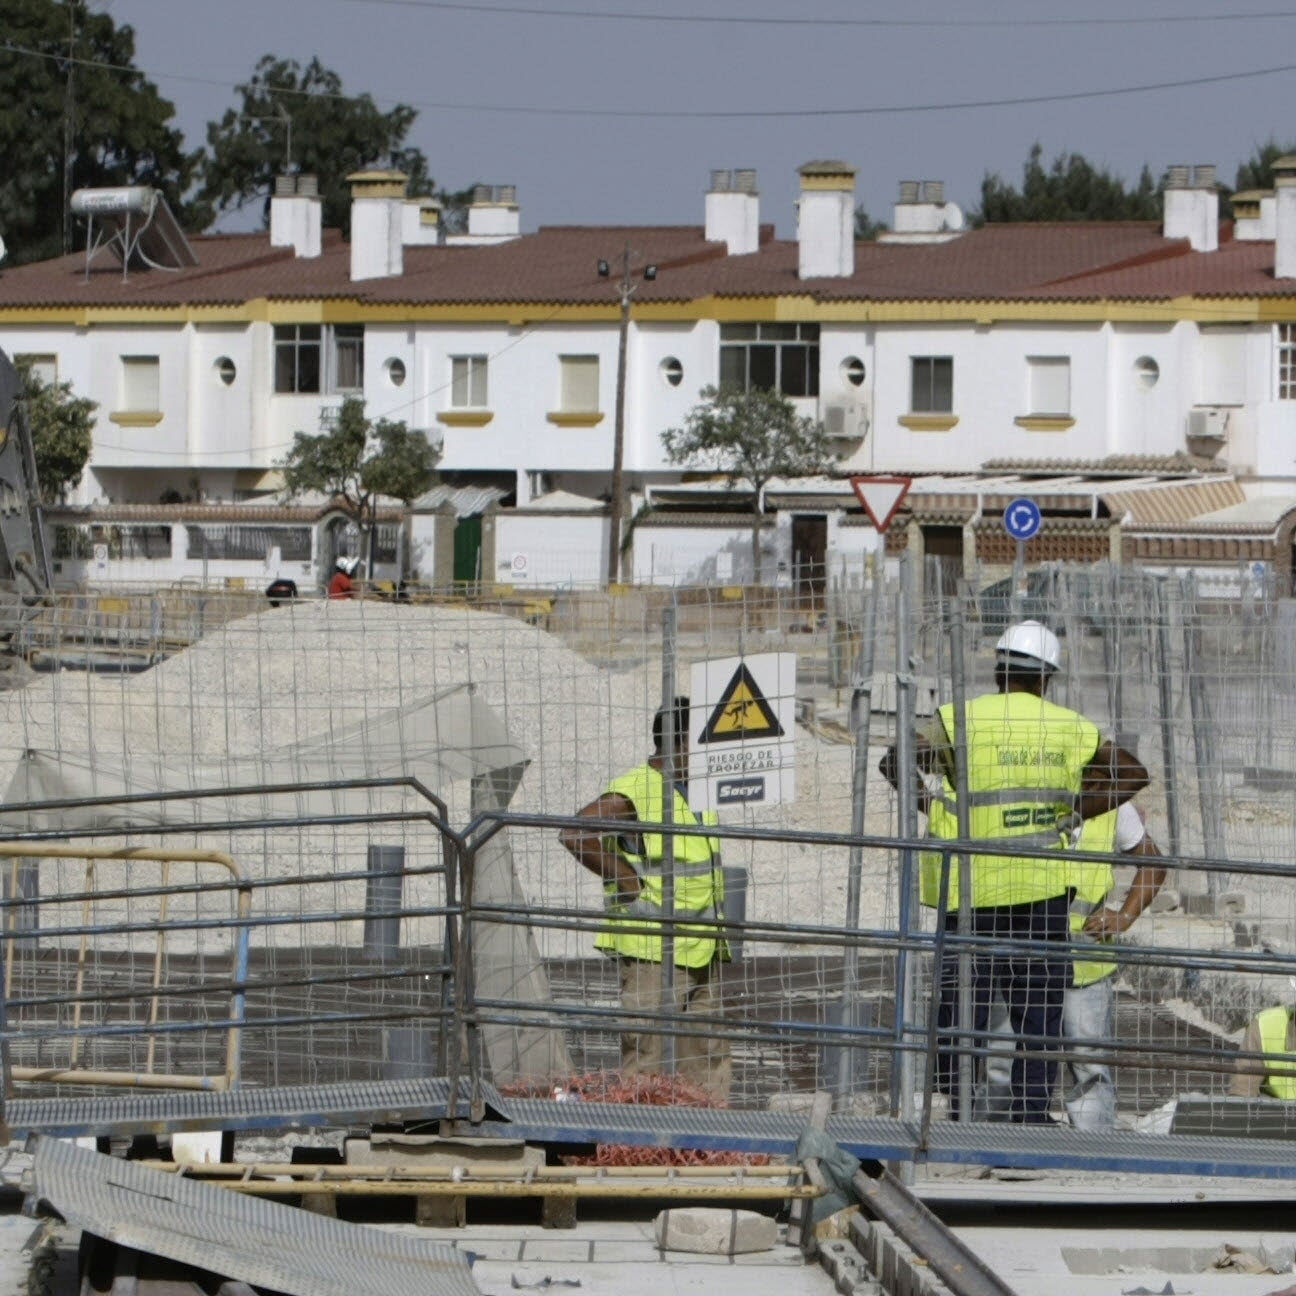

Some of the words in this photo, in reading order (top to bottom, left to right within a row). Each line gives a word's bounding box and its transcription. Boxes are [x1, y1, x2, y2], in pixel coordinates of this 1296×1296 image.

[709, 752, 753, 763] RIESGO
[758, 750, 773, 759] DE
[708, 761, 775, 773] TROPEZAR
[720, 785, 762, 797] Sacyr
